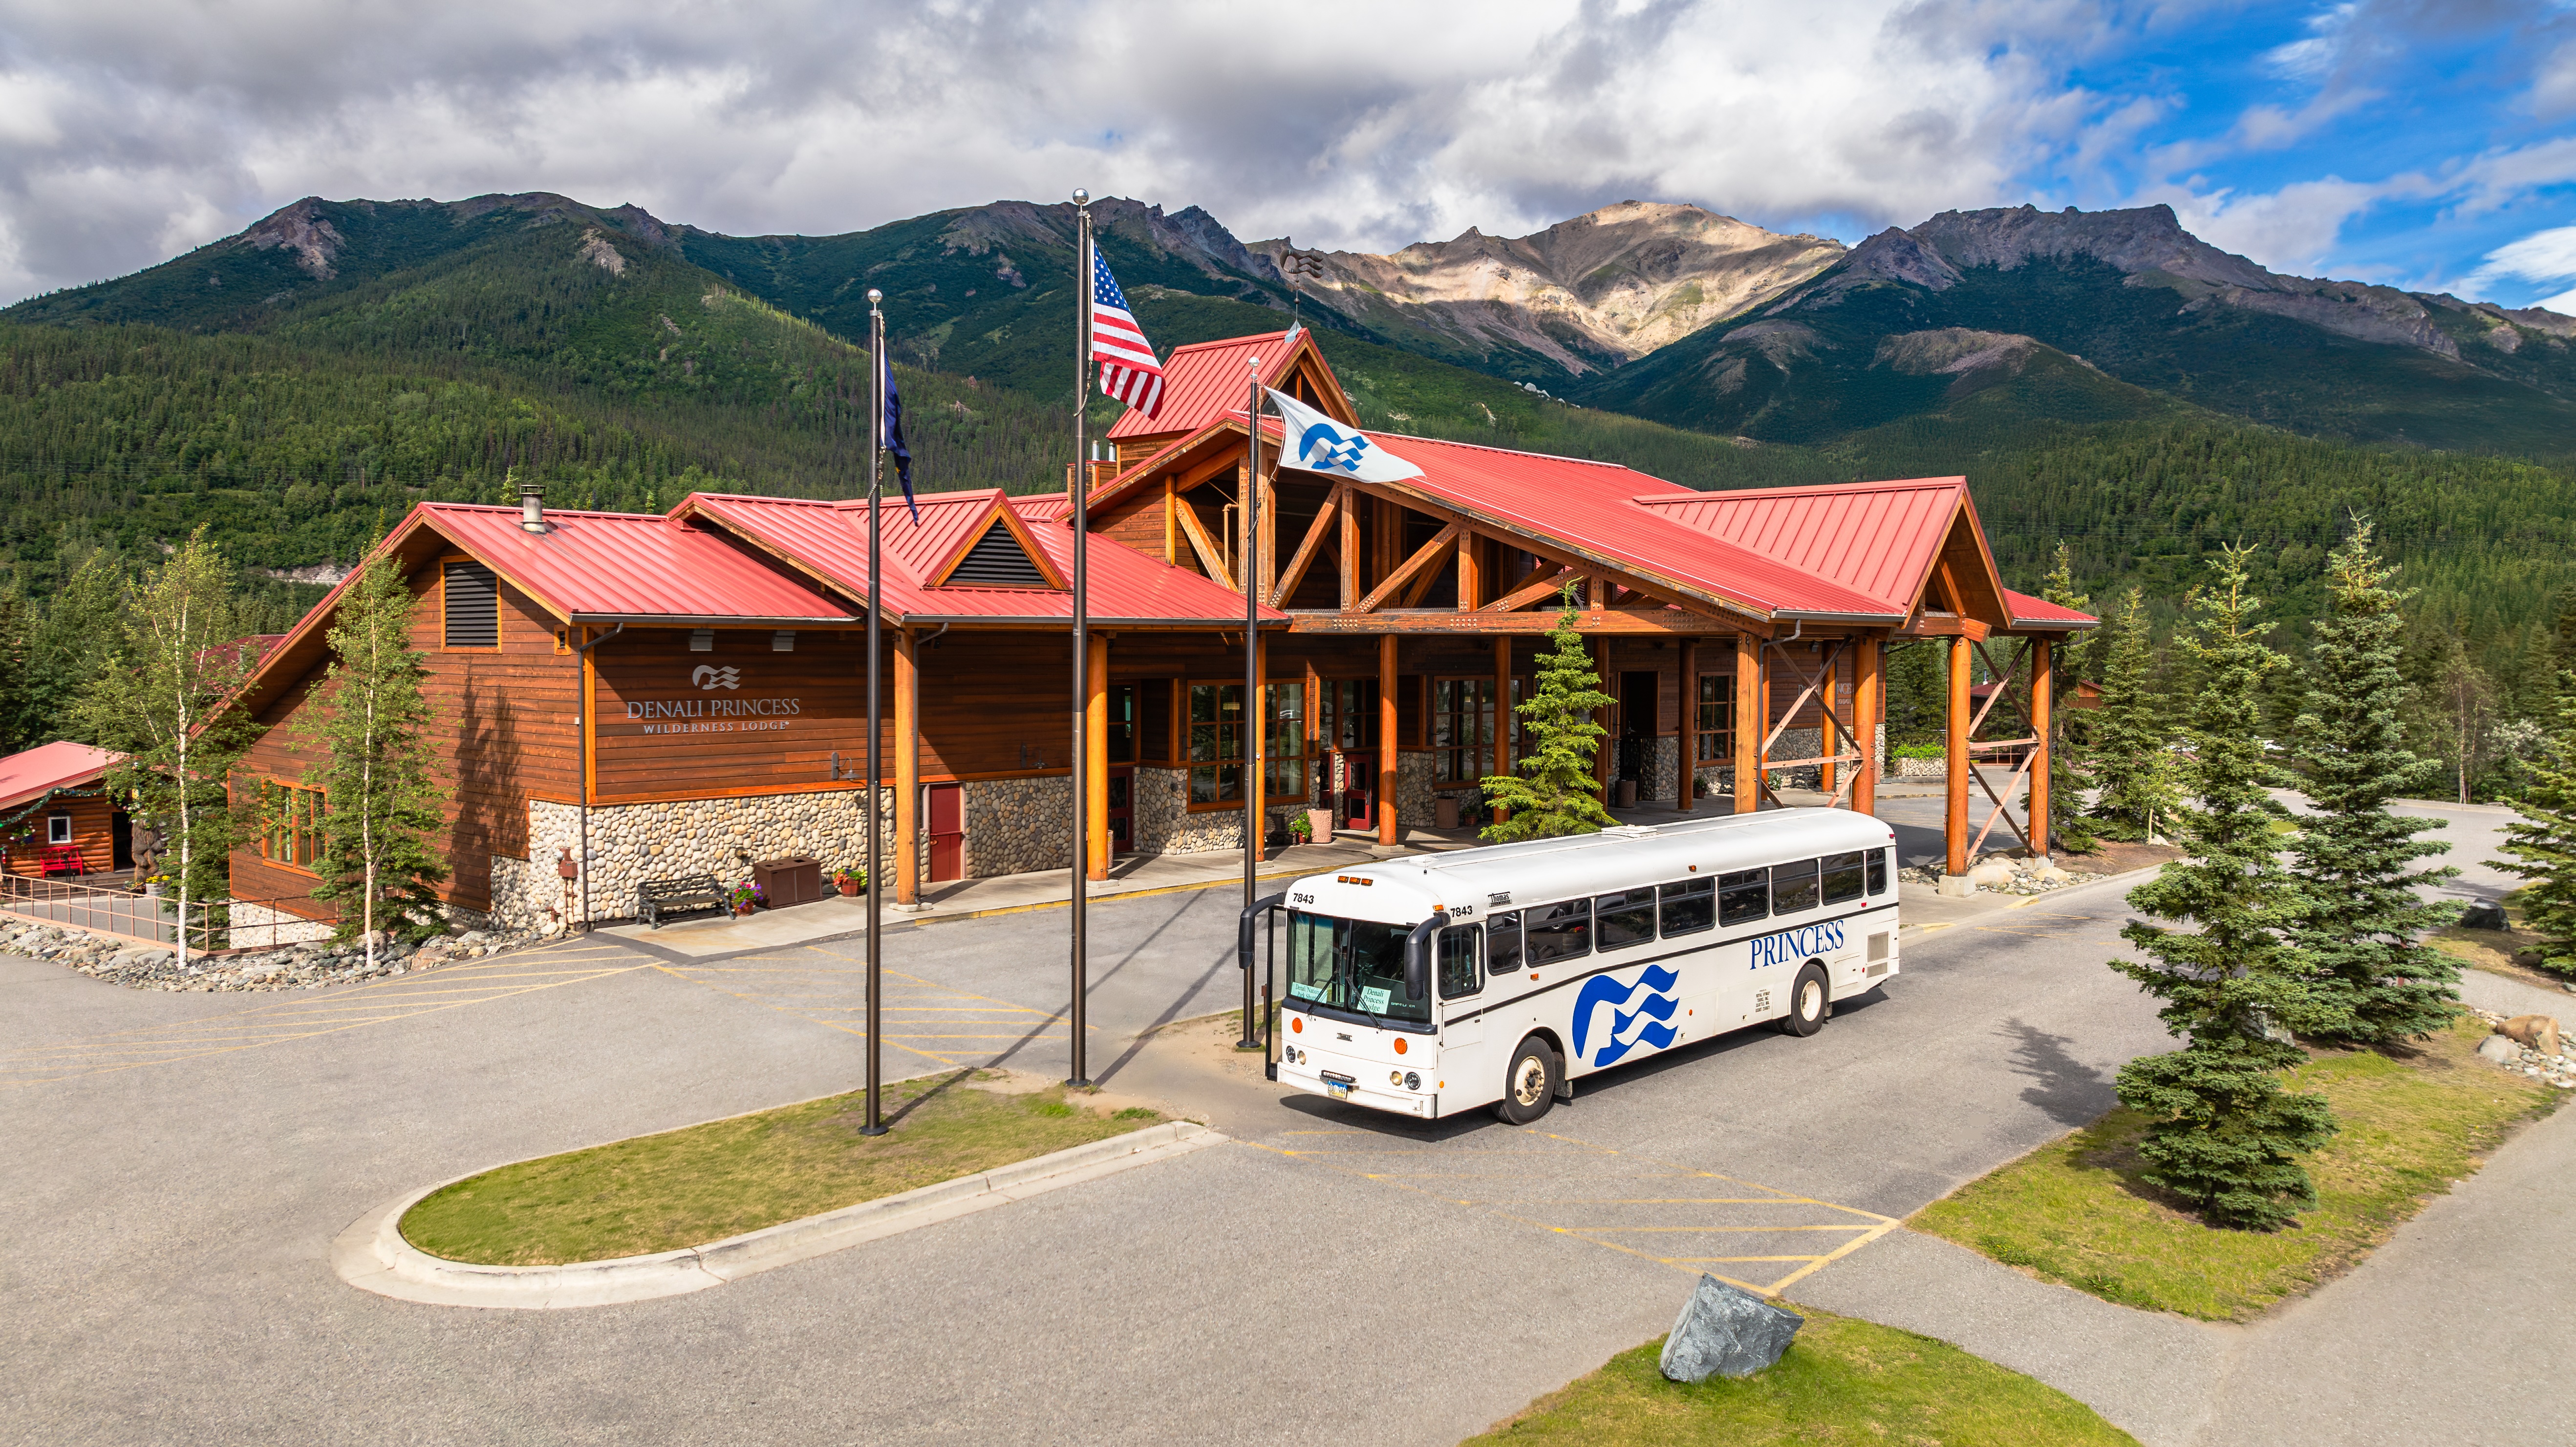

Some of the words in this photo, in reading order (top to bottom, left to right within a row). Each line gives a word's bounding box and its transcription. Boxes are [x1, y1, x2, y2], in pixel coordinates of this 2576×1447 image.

[627, 700, 703, 719] DENALI
[710, 699, 800, 716] PRINCESS
[643, 723, 733, 734] WILDERNESS
[1293, 893, 1314, 904] 7843
[1488, 891, 1511, 903] Thomas
[1450, 905, 1473, 917] 7843
[1750, 920, 1844, 970] PRINCESS
[1296, 983, 1306, 992] Denali
[1307, 987, 1321, 995] Nation
[1367, 988, 1384, 998] Denali
[1363, 995, 1384, 1005] Princess
[1367, 1003, 1380, 1012] odge
